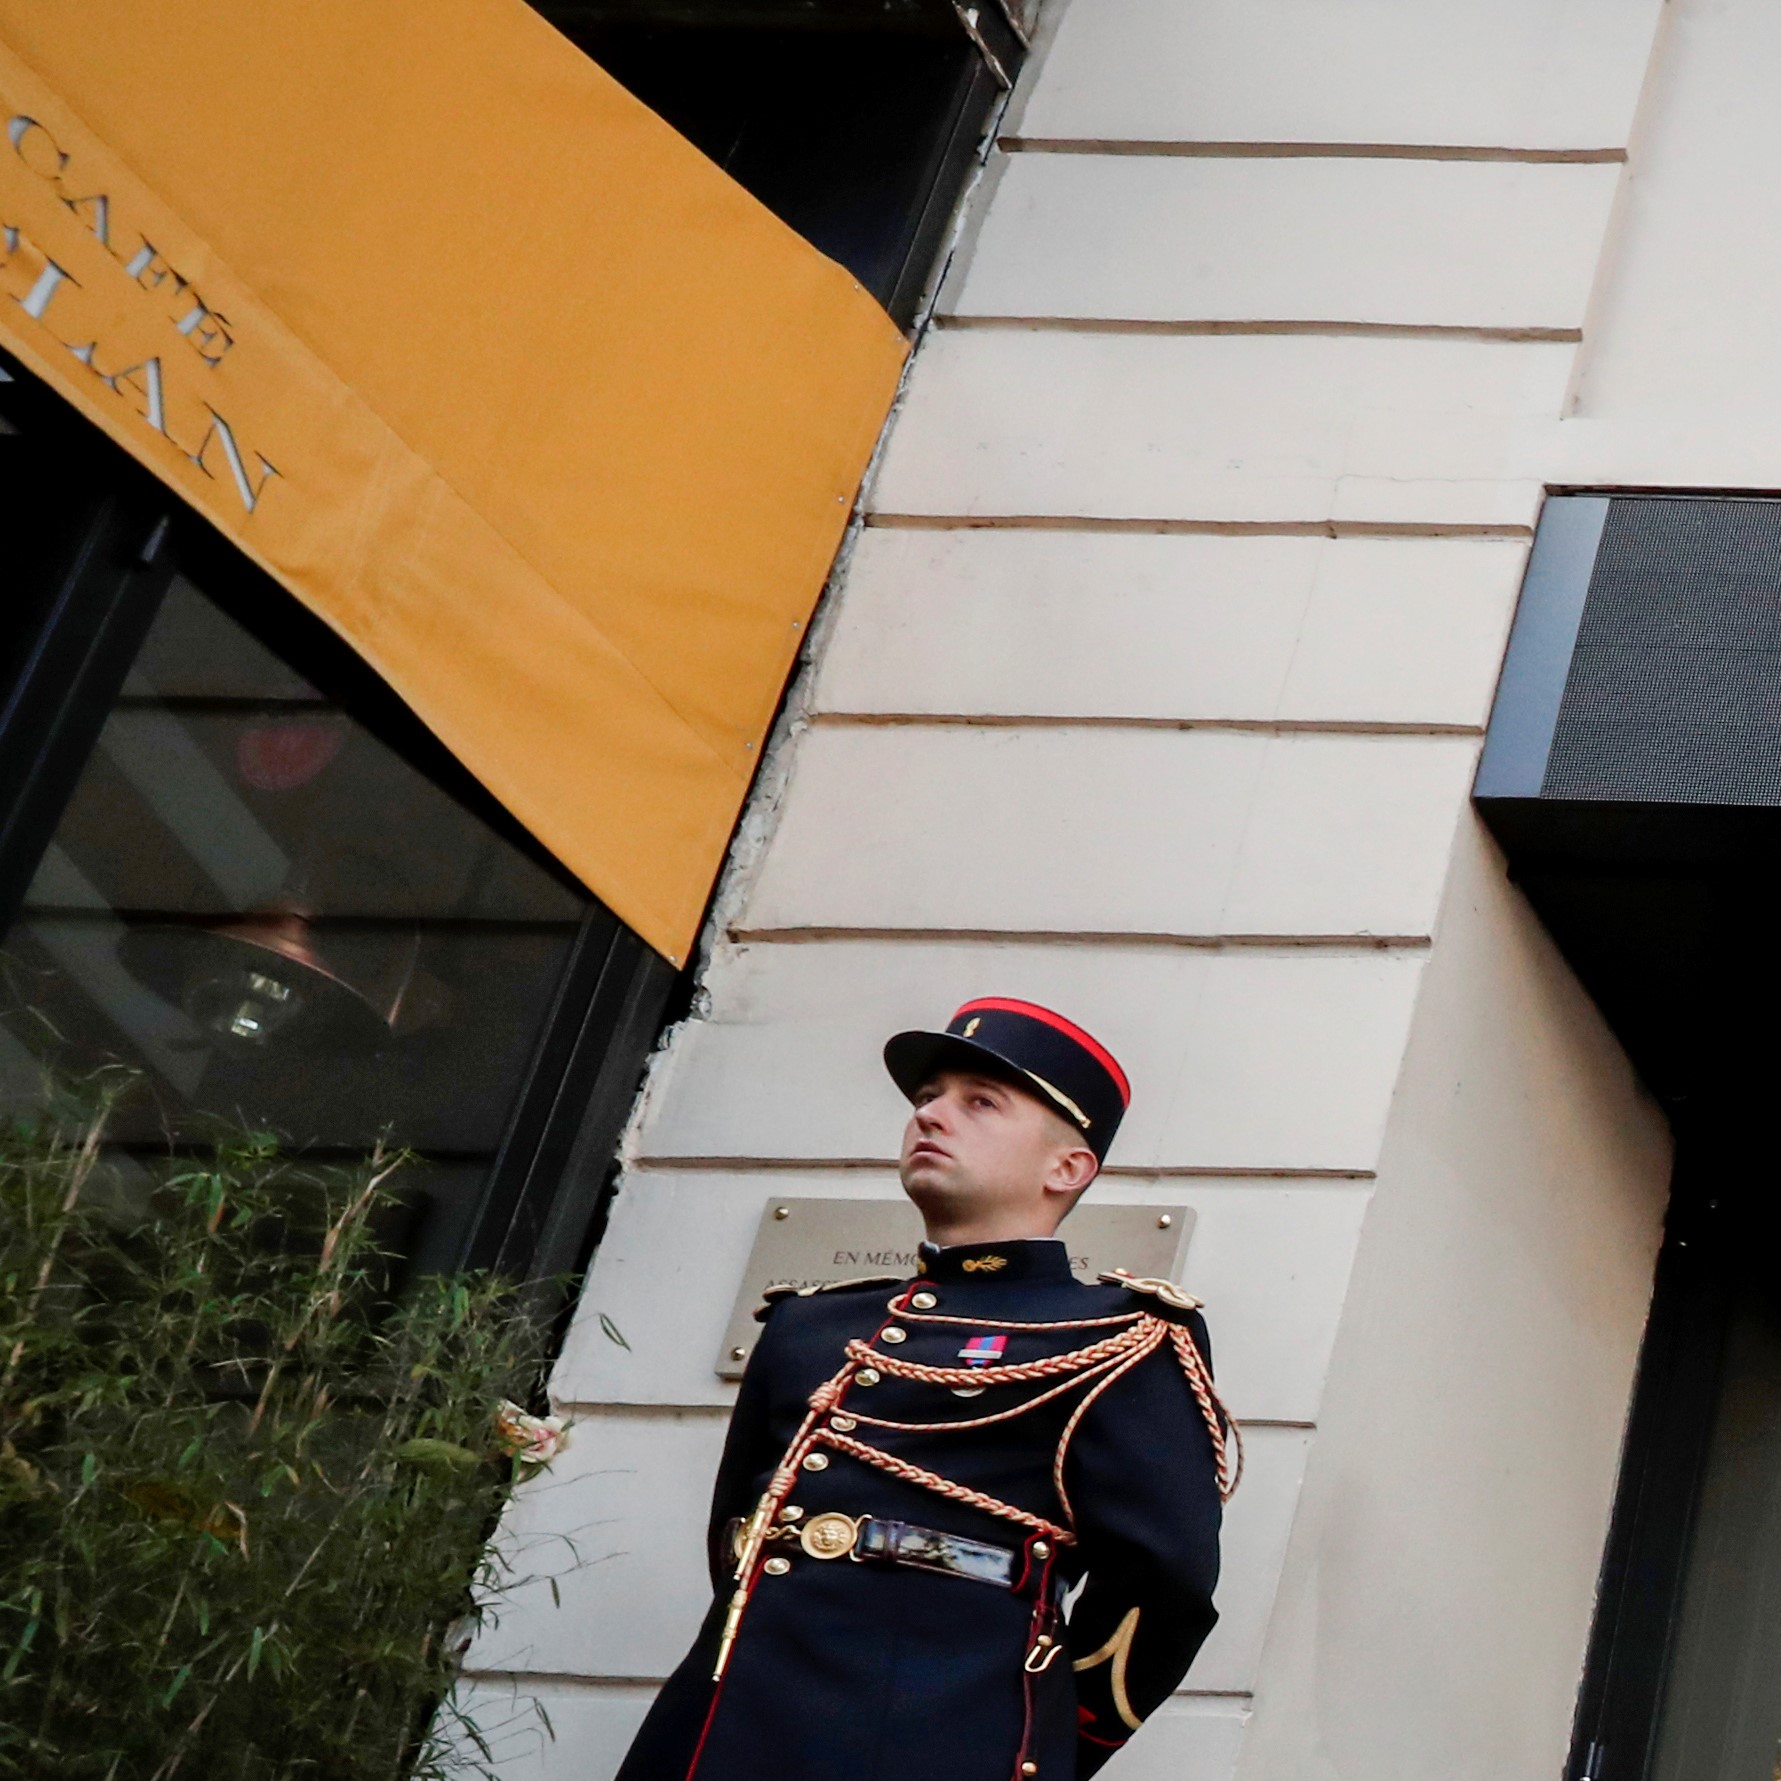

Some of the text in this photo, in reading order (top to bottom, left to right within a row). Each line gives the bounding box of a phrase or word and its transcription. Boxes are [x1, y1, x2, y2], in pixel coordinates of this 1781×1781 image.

[8, 114, 235, 368] CAFÉ
[0, 222, 285, 515] LAN
[833, 1251, 859, 1265] EN
